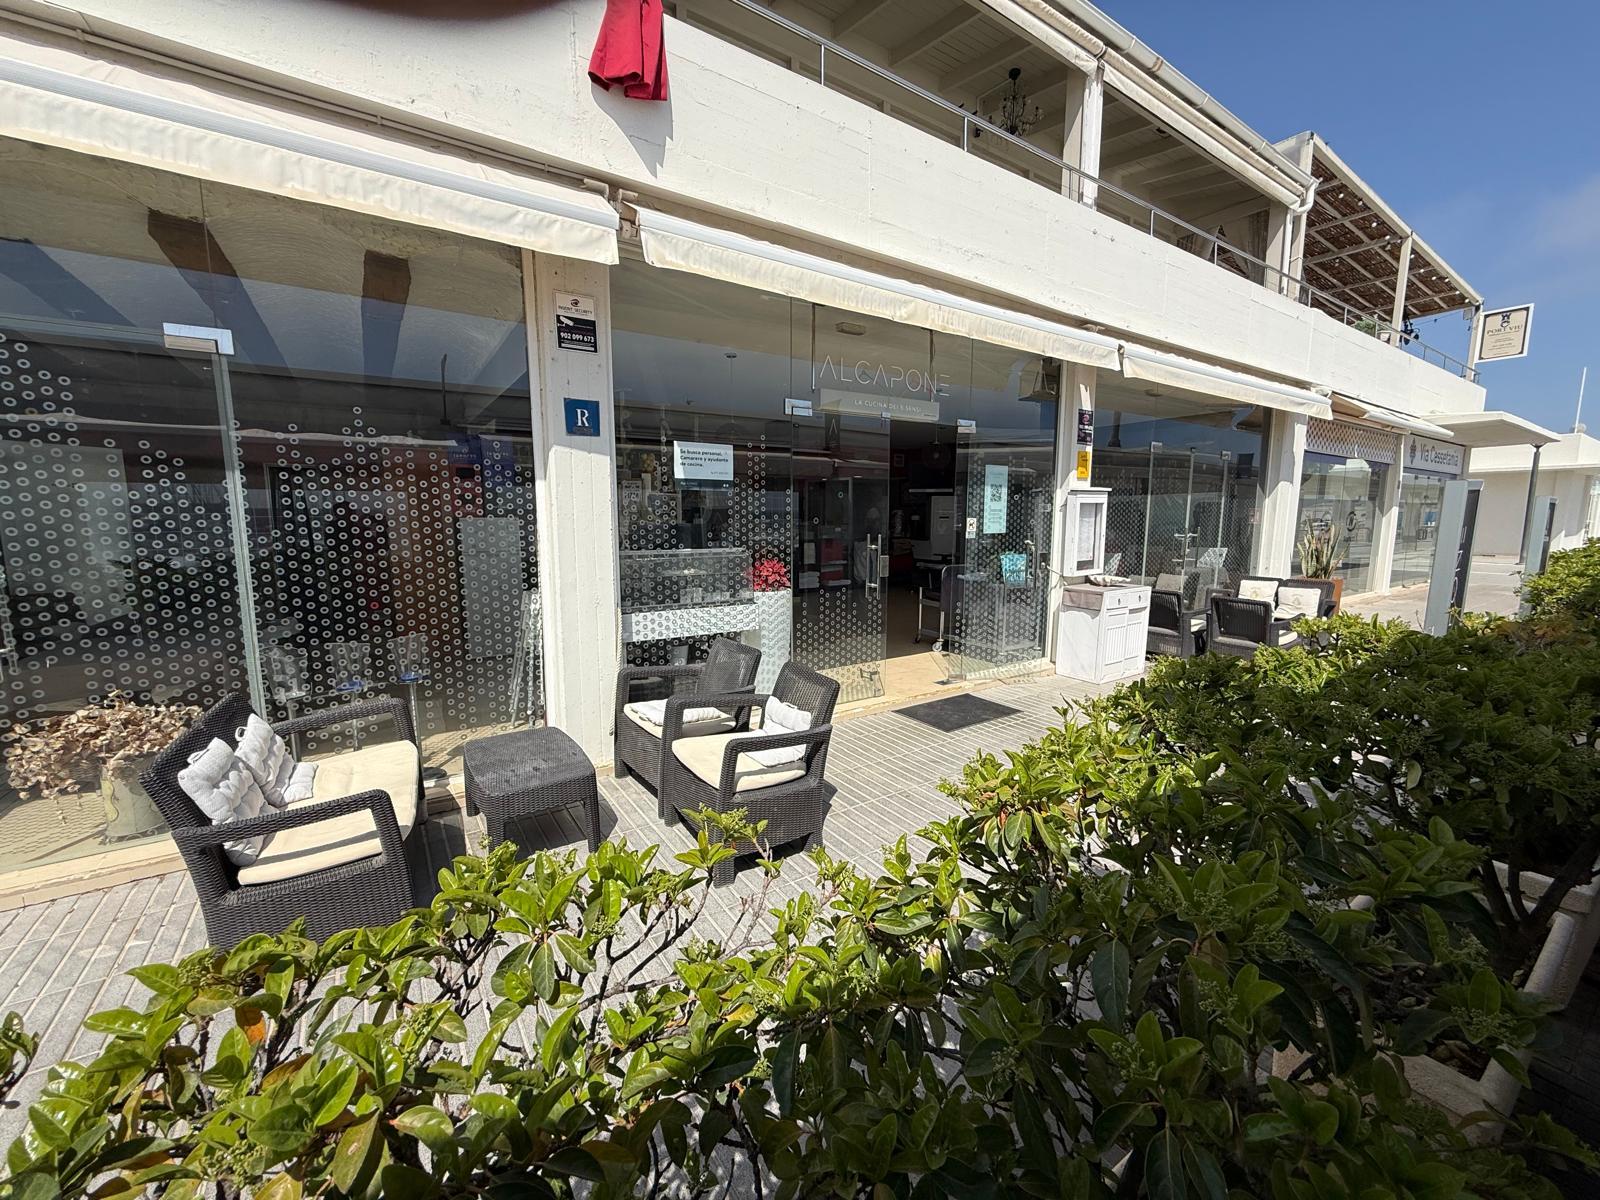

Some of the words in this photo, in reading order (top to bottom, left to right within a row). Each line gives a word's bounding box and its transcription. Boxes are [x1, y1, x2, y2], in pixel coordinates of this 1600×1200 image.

[572, 333, 583, 341] 099
[820, 354, 951, 397] ALCAPONE
[864, 400, 888, 409] CUCINA
[576, 408, 589, 427] R
[1420, 443, 1430, 462] Via
